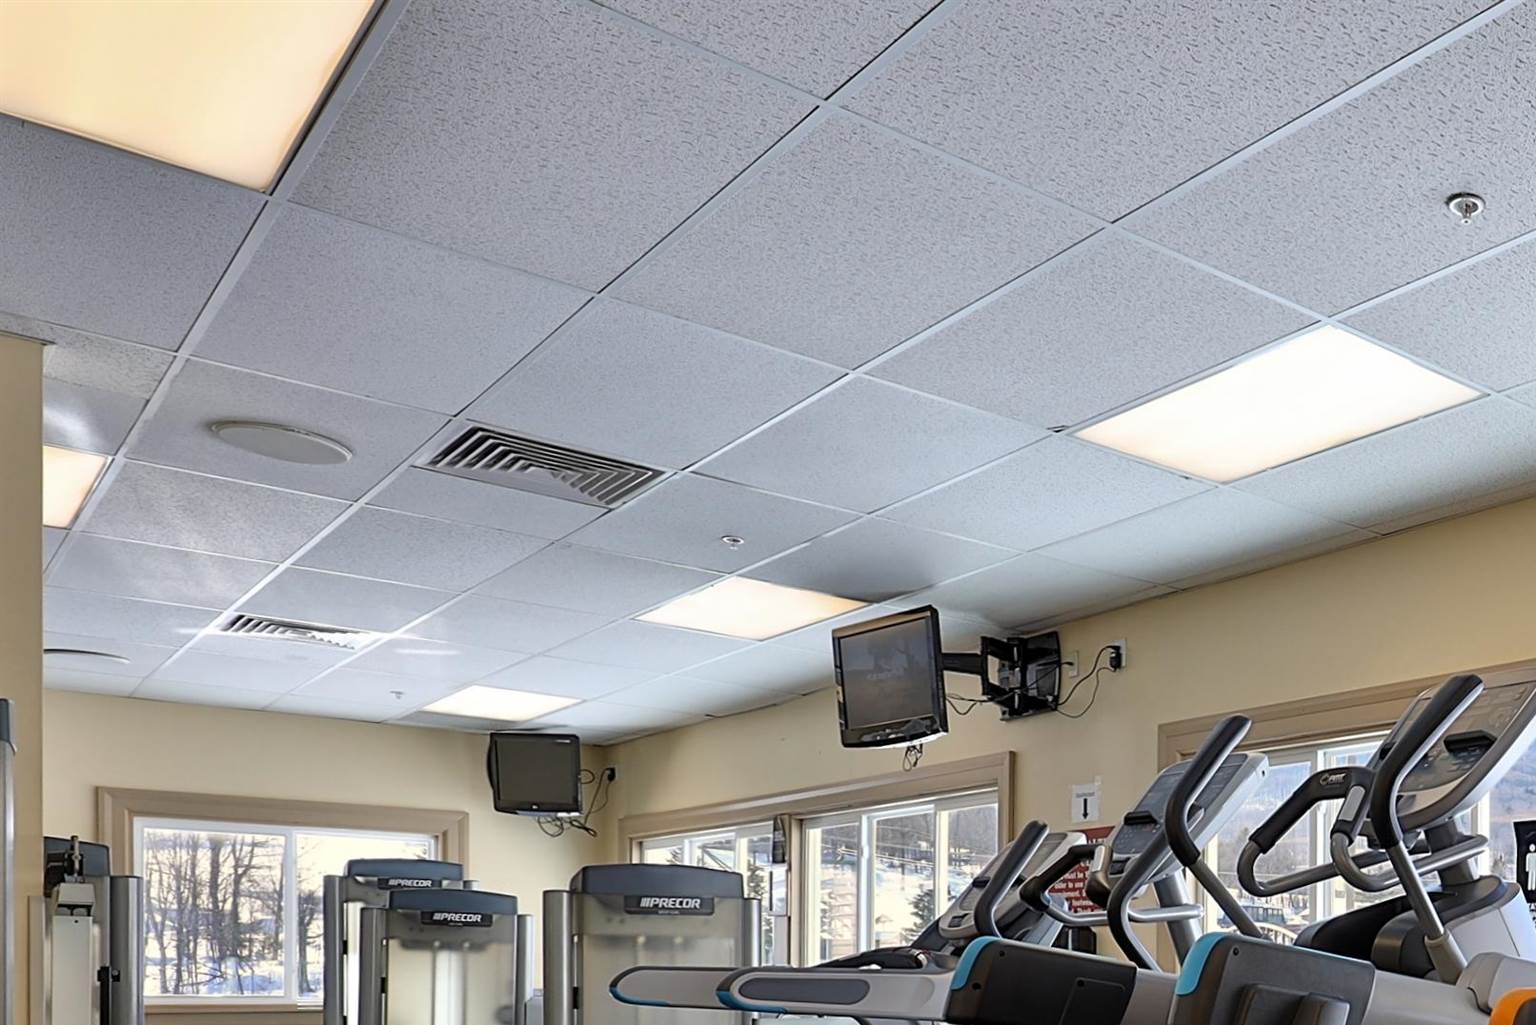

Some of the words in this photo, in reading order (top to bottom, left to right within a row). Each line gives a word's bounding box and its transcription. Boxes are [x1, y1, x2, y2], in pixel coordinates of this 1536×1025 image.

[392, 879, 432, 887] PRECOR
[649, 897, 701, 909] PRECOR
[439, 912, 482, 922] PRECOR
